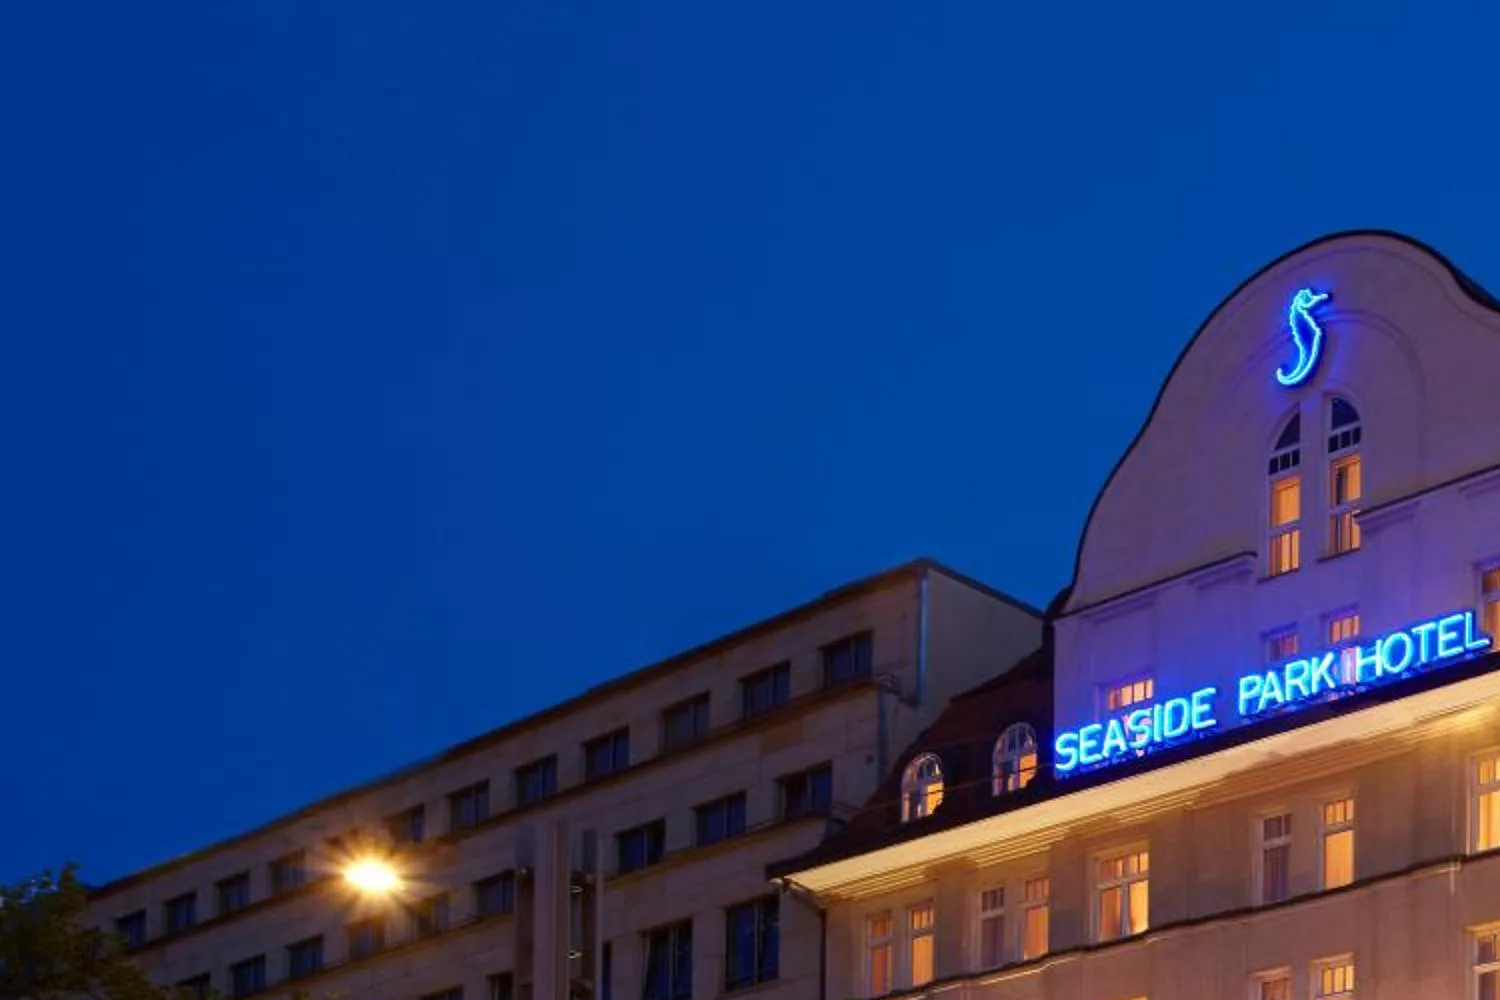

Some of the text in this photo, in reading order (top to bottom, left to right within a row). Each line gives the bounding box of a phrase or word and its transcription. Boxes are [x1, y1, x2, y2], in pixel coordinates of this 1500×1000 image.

[1055, 610, 1490, 773] SEASIDE PARK HOTEL
